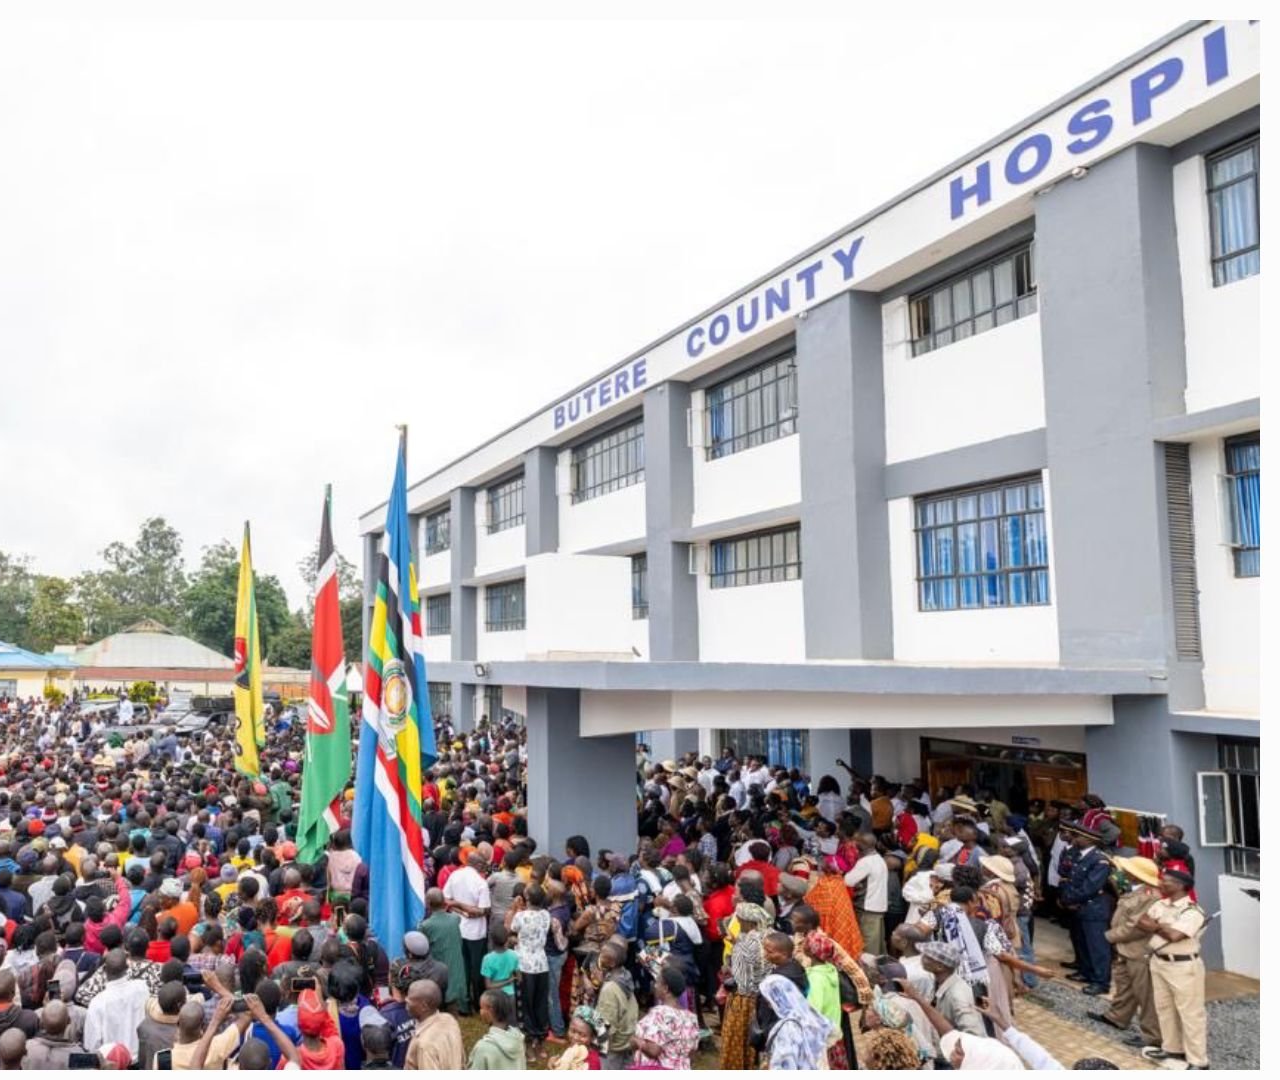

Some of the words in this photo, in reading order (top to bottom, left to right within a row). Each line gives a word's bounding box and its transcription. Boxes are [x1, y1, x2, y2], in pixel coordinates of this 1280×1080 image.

[553, 359, 648, 430] BUTERE
[686, 236, 865, 358] COUNTY
[949, 26, 1229, 220] HOSPI
